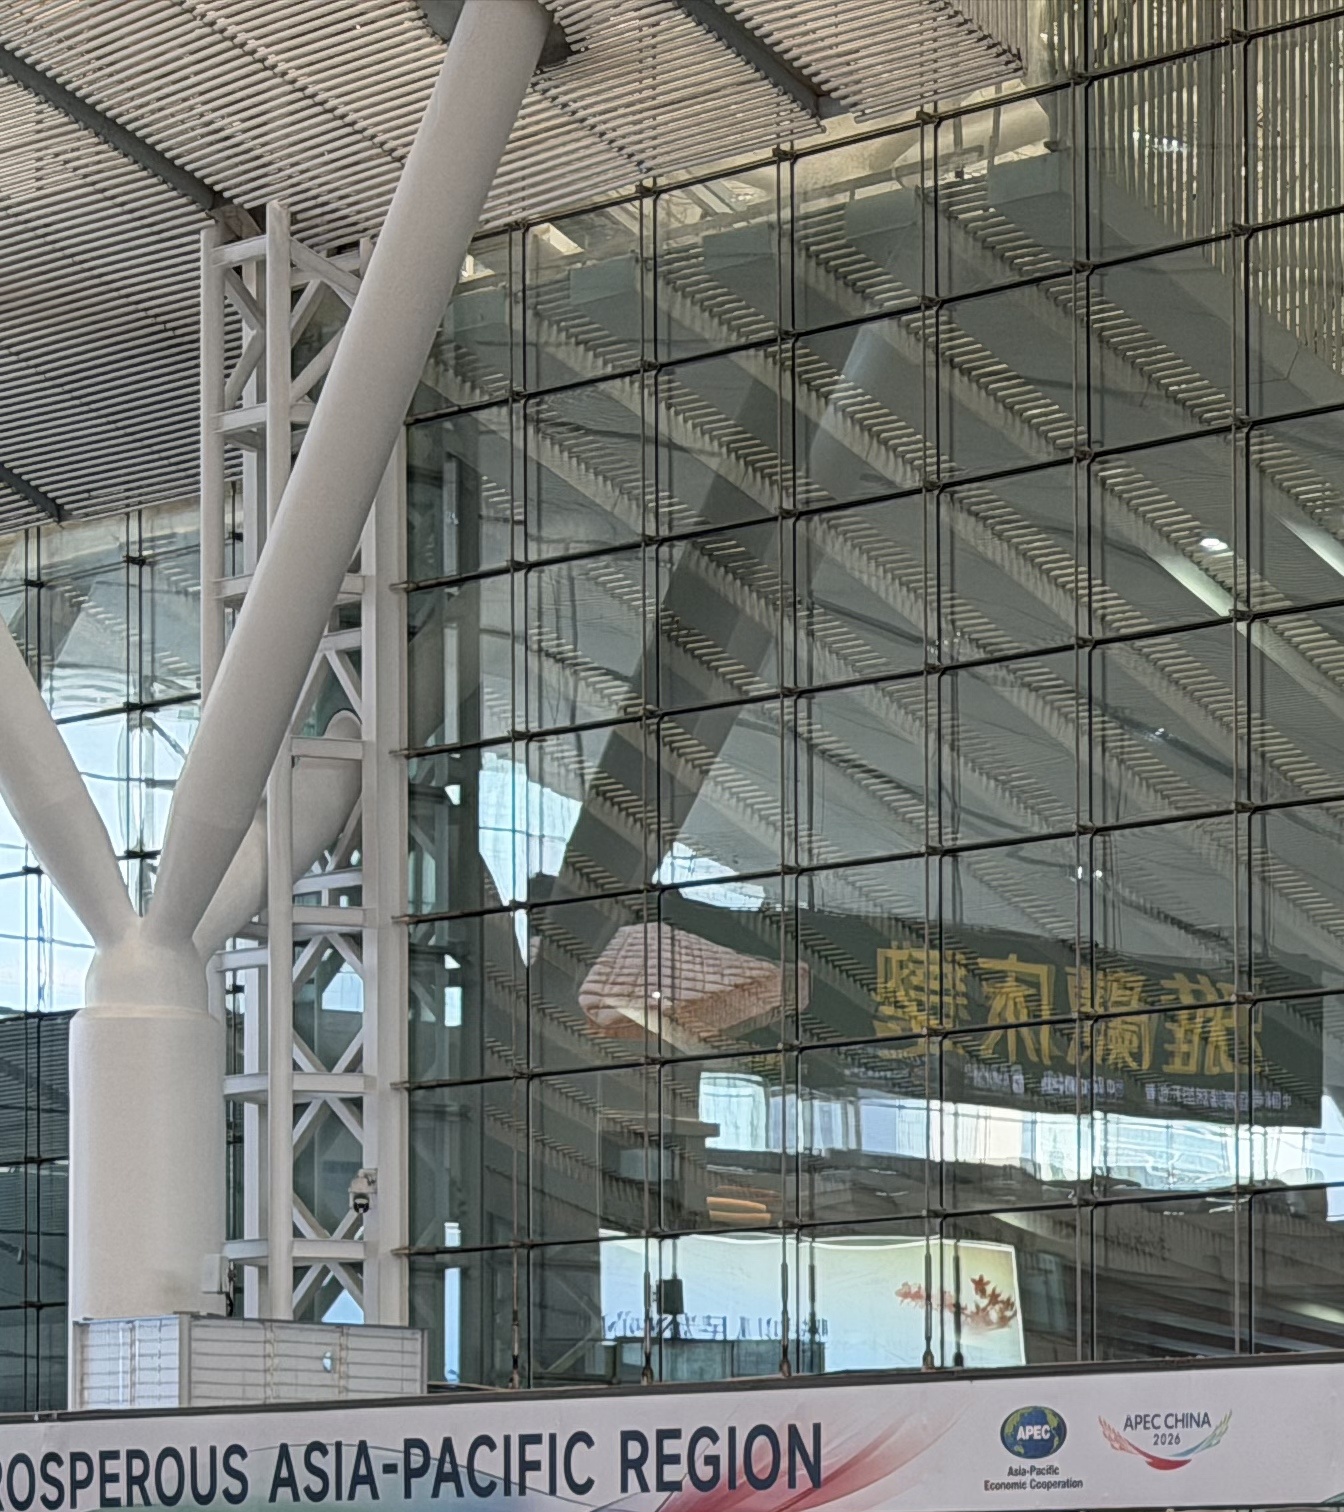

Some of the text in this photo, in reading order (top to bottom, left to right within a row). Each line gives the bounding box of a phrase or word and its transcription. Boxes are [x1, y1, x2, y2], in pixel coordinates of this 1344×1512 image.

[1123, 1411, 1212, 1431] APEC CHINA
[1016, 1424, 1051, 1440] APEC
[1152, 1432, 1181, 1446] 2026
[0, 1420, 823, 1512] OSPEROUS ASIA-PACIFIC REGION
[1007, 1465, 1060, 1477] Asia-Pacific
[984, 1478, 1083, 1492] Economic Cooperation
